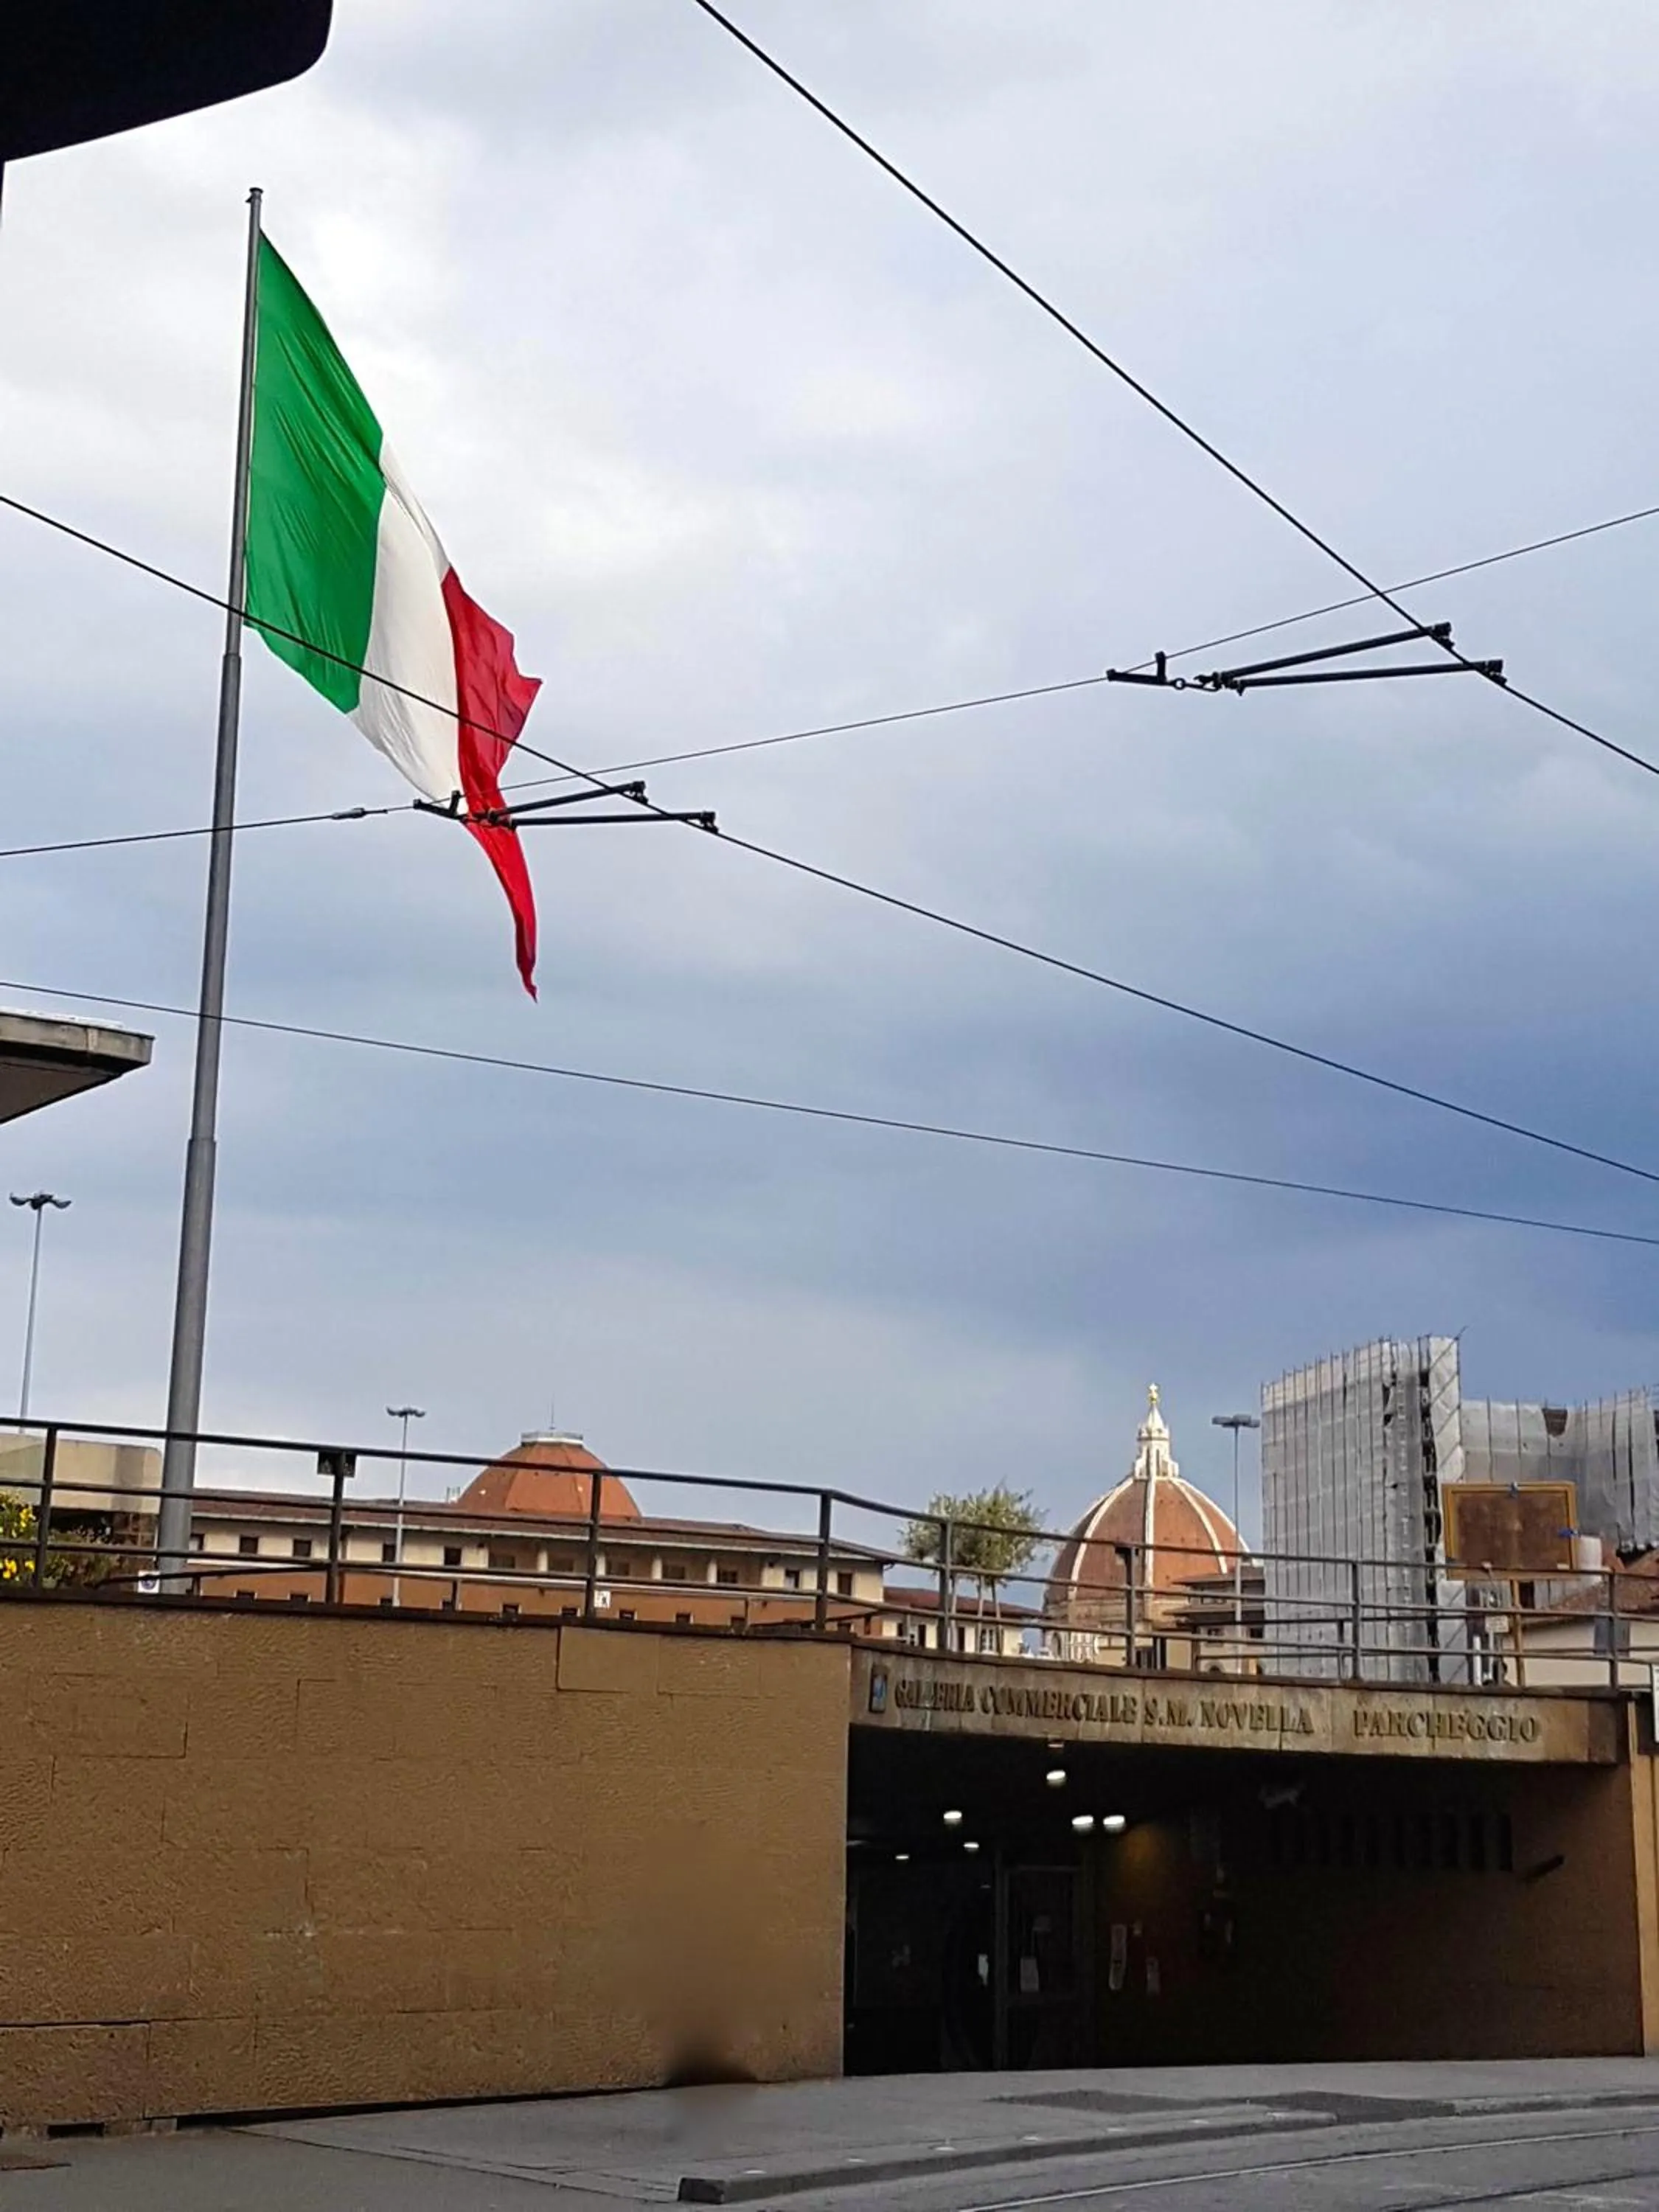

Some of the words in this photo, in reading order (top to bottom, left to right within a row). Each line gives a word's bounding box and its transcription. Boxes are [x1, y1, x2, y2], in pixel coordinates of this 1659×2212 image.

[979, 1686, 1137, 1725] COMMERCIALE
[1199, 1700, 1314, 1733] NOVELLA
[1353, 1708, 1540, 1742] PARCHEGGIO
